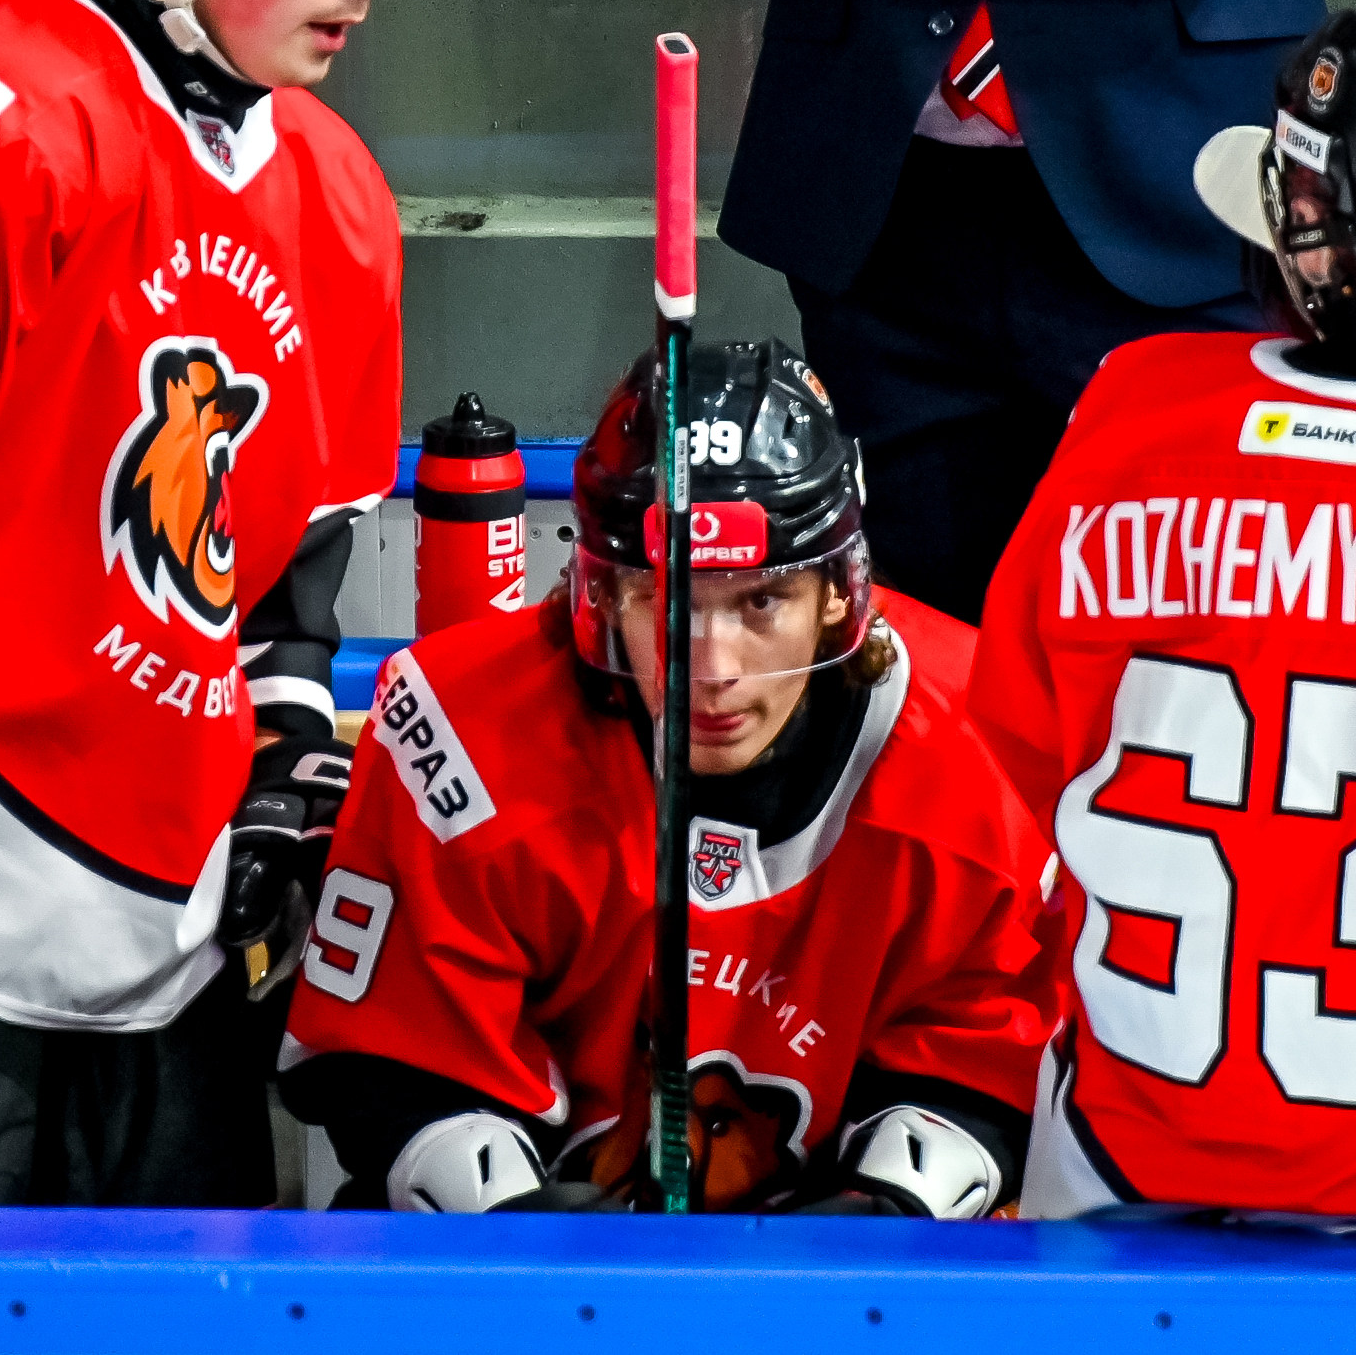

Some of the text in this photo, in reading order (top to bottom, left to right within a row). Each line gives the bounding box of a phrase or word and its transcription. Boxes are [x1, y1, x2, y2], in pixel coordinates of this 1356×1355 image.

[650, 546, 757, 563] MPBET
[701, 842, 740, 859] МХЛ
[300, 867, 395, 1004] 9
